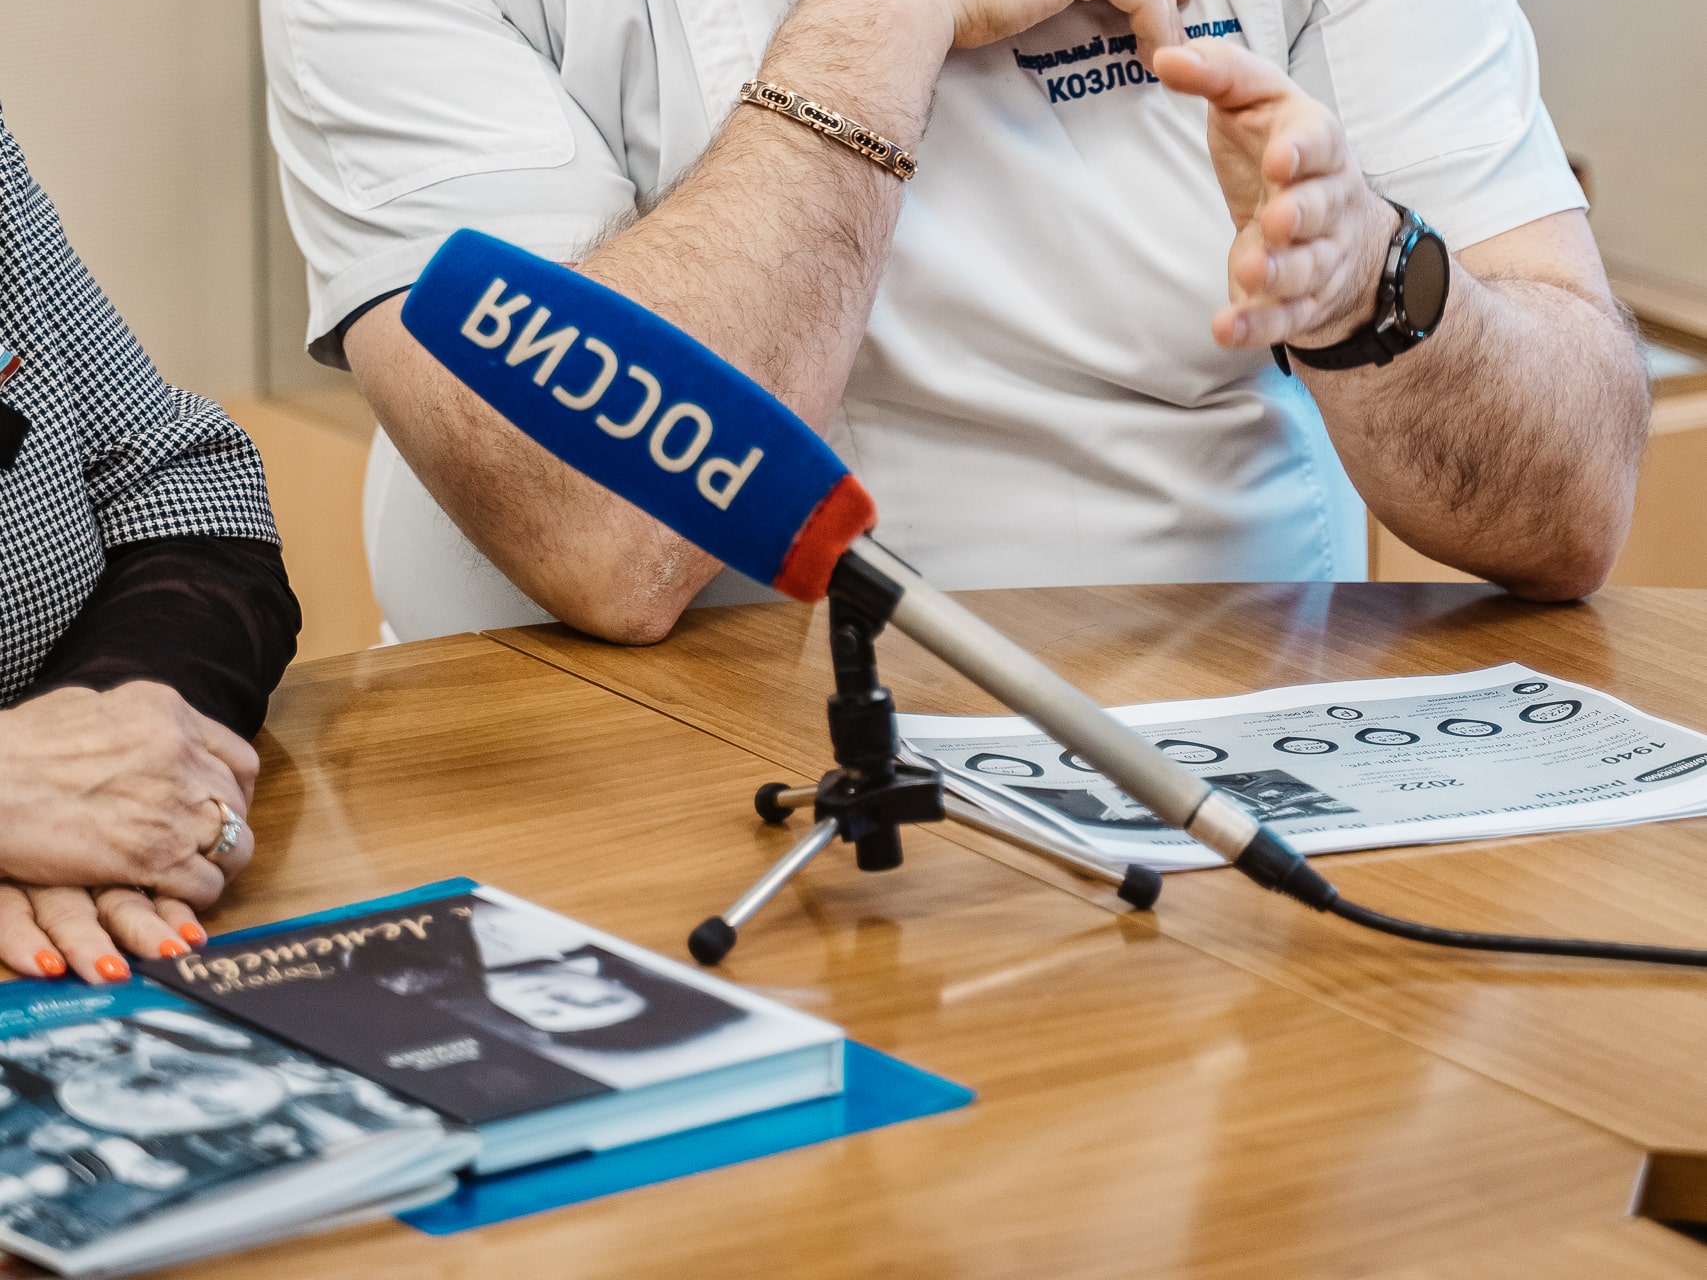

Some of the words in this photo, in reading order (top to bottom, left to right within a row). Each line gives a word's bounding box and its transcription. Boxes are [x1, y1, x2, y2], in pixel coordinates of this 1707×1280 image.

[460, 277, 764, 511] РОССИЯ
[1557, 718, 1630, 742] Инвестиции
[1601, 742, 1666, 764] 1940
[1393, 779, 1465, 792] 2022
[1535, 780, 1627, 799] работы
